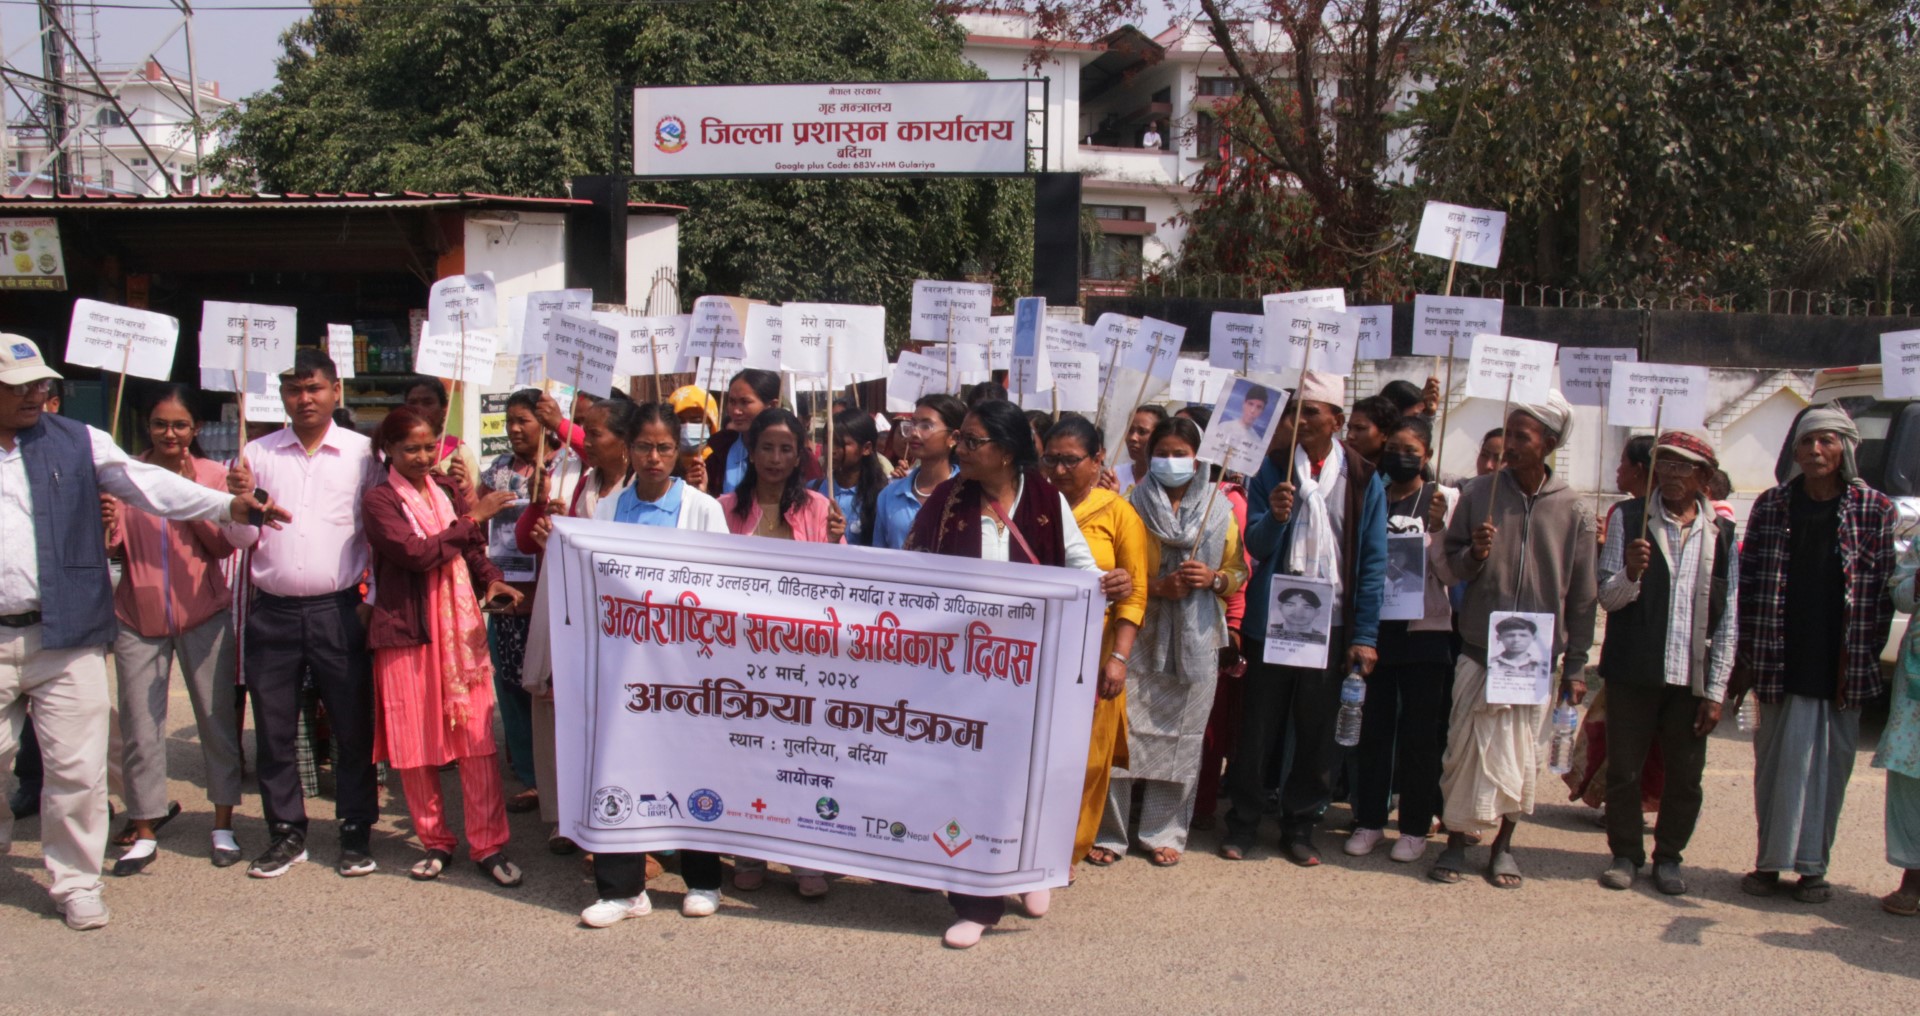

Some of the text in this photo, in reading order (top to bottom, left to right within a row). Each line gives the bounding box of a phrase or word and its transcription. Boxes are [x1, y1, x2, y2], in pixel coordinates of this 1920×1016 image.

[829, 88, 881, 96] नेपाल सरकार
[818, 102, 892, 115] गृह मन्त्रालय
[700, 115, 1014, 145] जिल्ला प्रशासन कार्यालय
[837, 146, 872, 158] बर्दिया
[775, 162, 804, 170] Google
[808, 162, 824, 171] plus
[854, 161, 896, 169] 683V+HM
[899, 161, 936, 170] Gulariya
[1448, 212, 1490, 227] हाम्रो मान्छे
[228, 315, 277, 330] हाम्रो मान्छे
[801, 314, 846, 329] मेरो बाबा
[1291, 316, 1340, 334] हाम्रो मान्छे
[630, 325, 676, 338] हाम्रो मान्छे
[598, 559, 632, 578] गम्भिर
[635, 566, 664, 581] मानव
[669, 567, 713, 587] अधिकार
[849, 585, 884, 606] मर्यादा
[888, 591, 896, 606] र
[899, 592, 940, 611] सत्यको
[943, 595, 1004, 618] अधिकारका
[1008, 602, 1036, 621] लागि
[744, 606, 842, 658] सत्यको
[848, 611, 960, 674] अधिकार
[964, 620, 1038, 686] दिवस
[746, 664, 860, 689] २४ मार्च, २०२४
[824, 700, 988, 751] कार्यक्रम
[728, 732, 764, 750] स्थान
[783, 736, 838, 760] गुलरिया,
[848, 744, 888, 766] बर्दिया
[776, 768, 836, 788] आयोजक
[906, 831, 930, 842] Nepal
